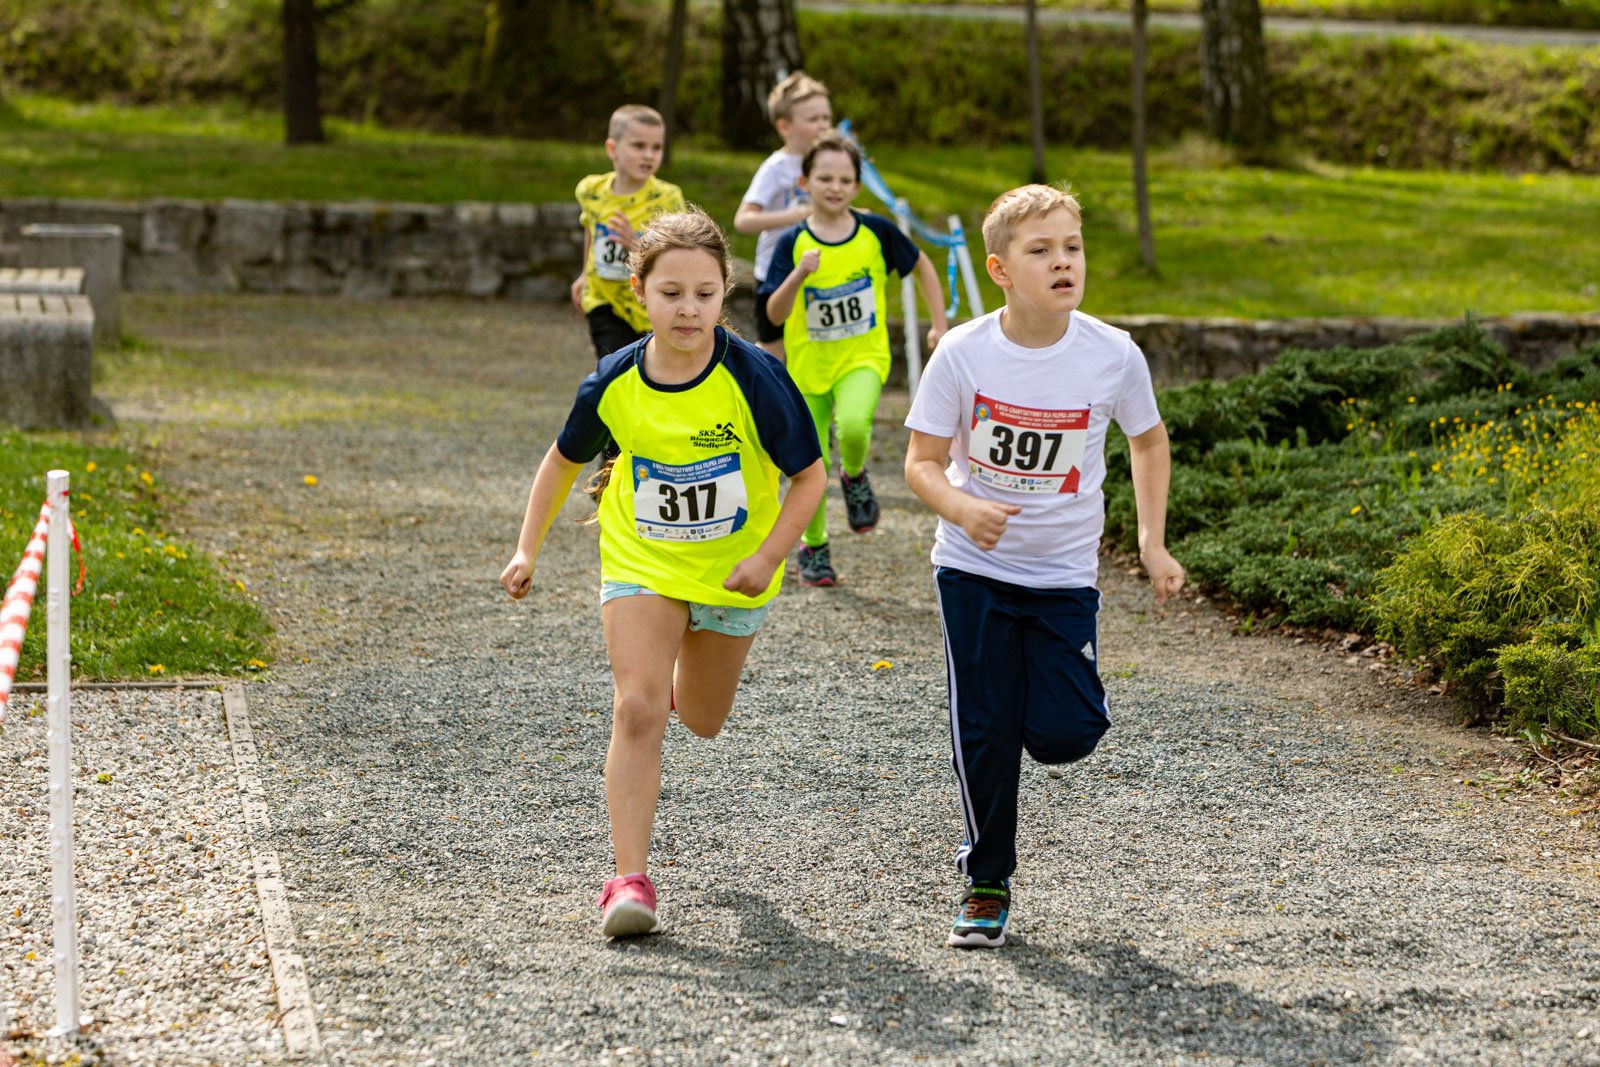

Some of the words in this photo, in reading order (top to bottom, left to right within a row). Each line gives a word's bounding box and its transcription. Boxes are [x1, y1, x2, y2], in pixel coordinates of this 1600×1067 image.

[818, 296, 862, 327] 318
[697, 429, 716, 437] SKS
[989, 425, 1063, 471] 397
[658, 482, 717, 522] 317
